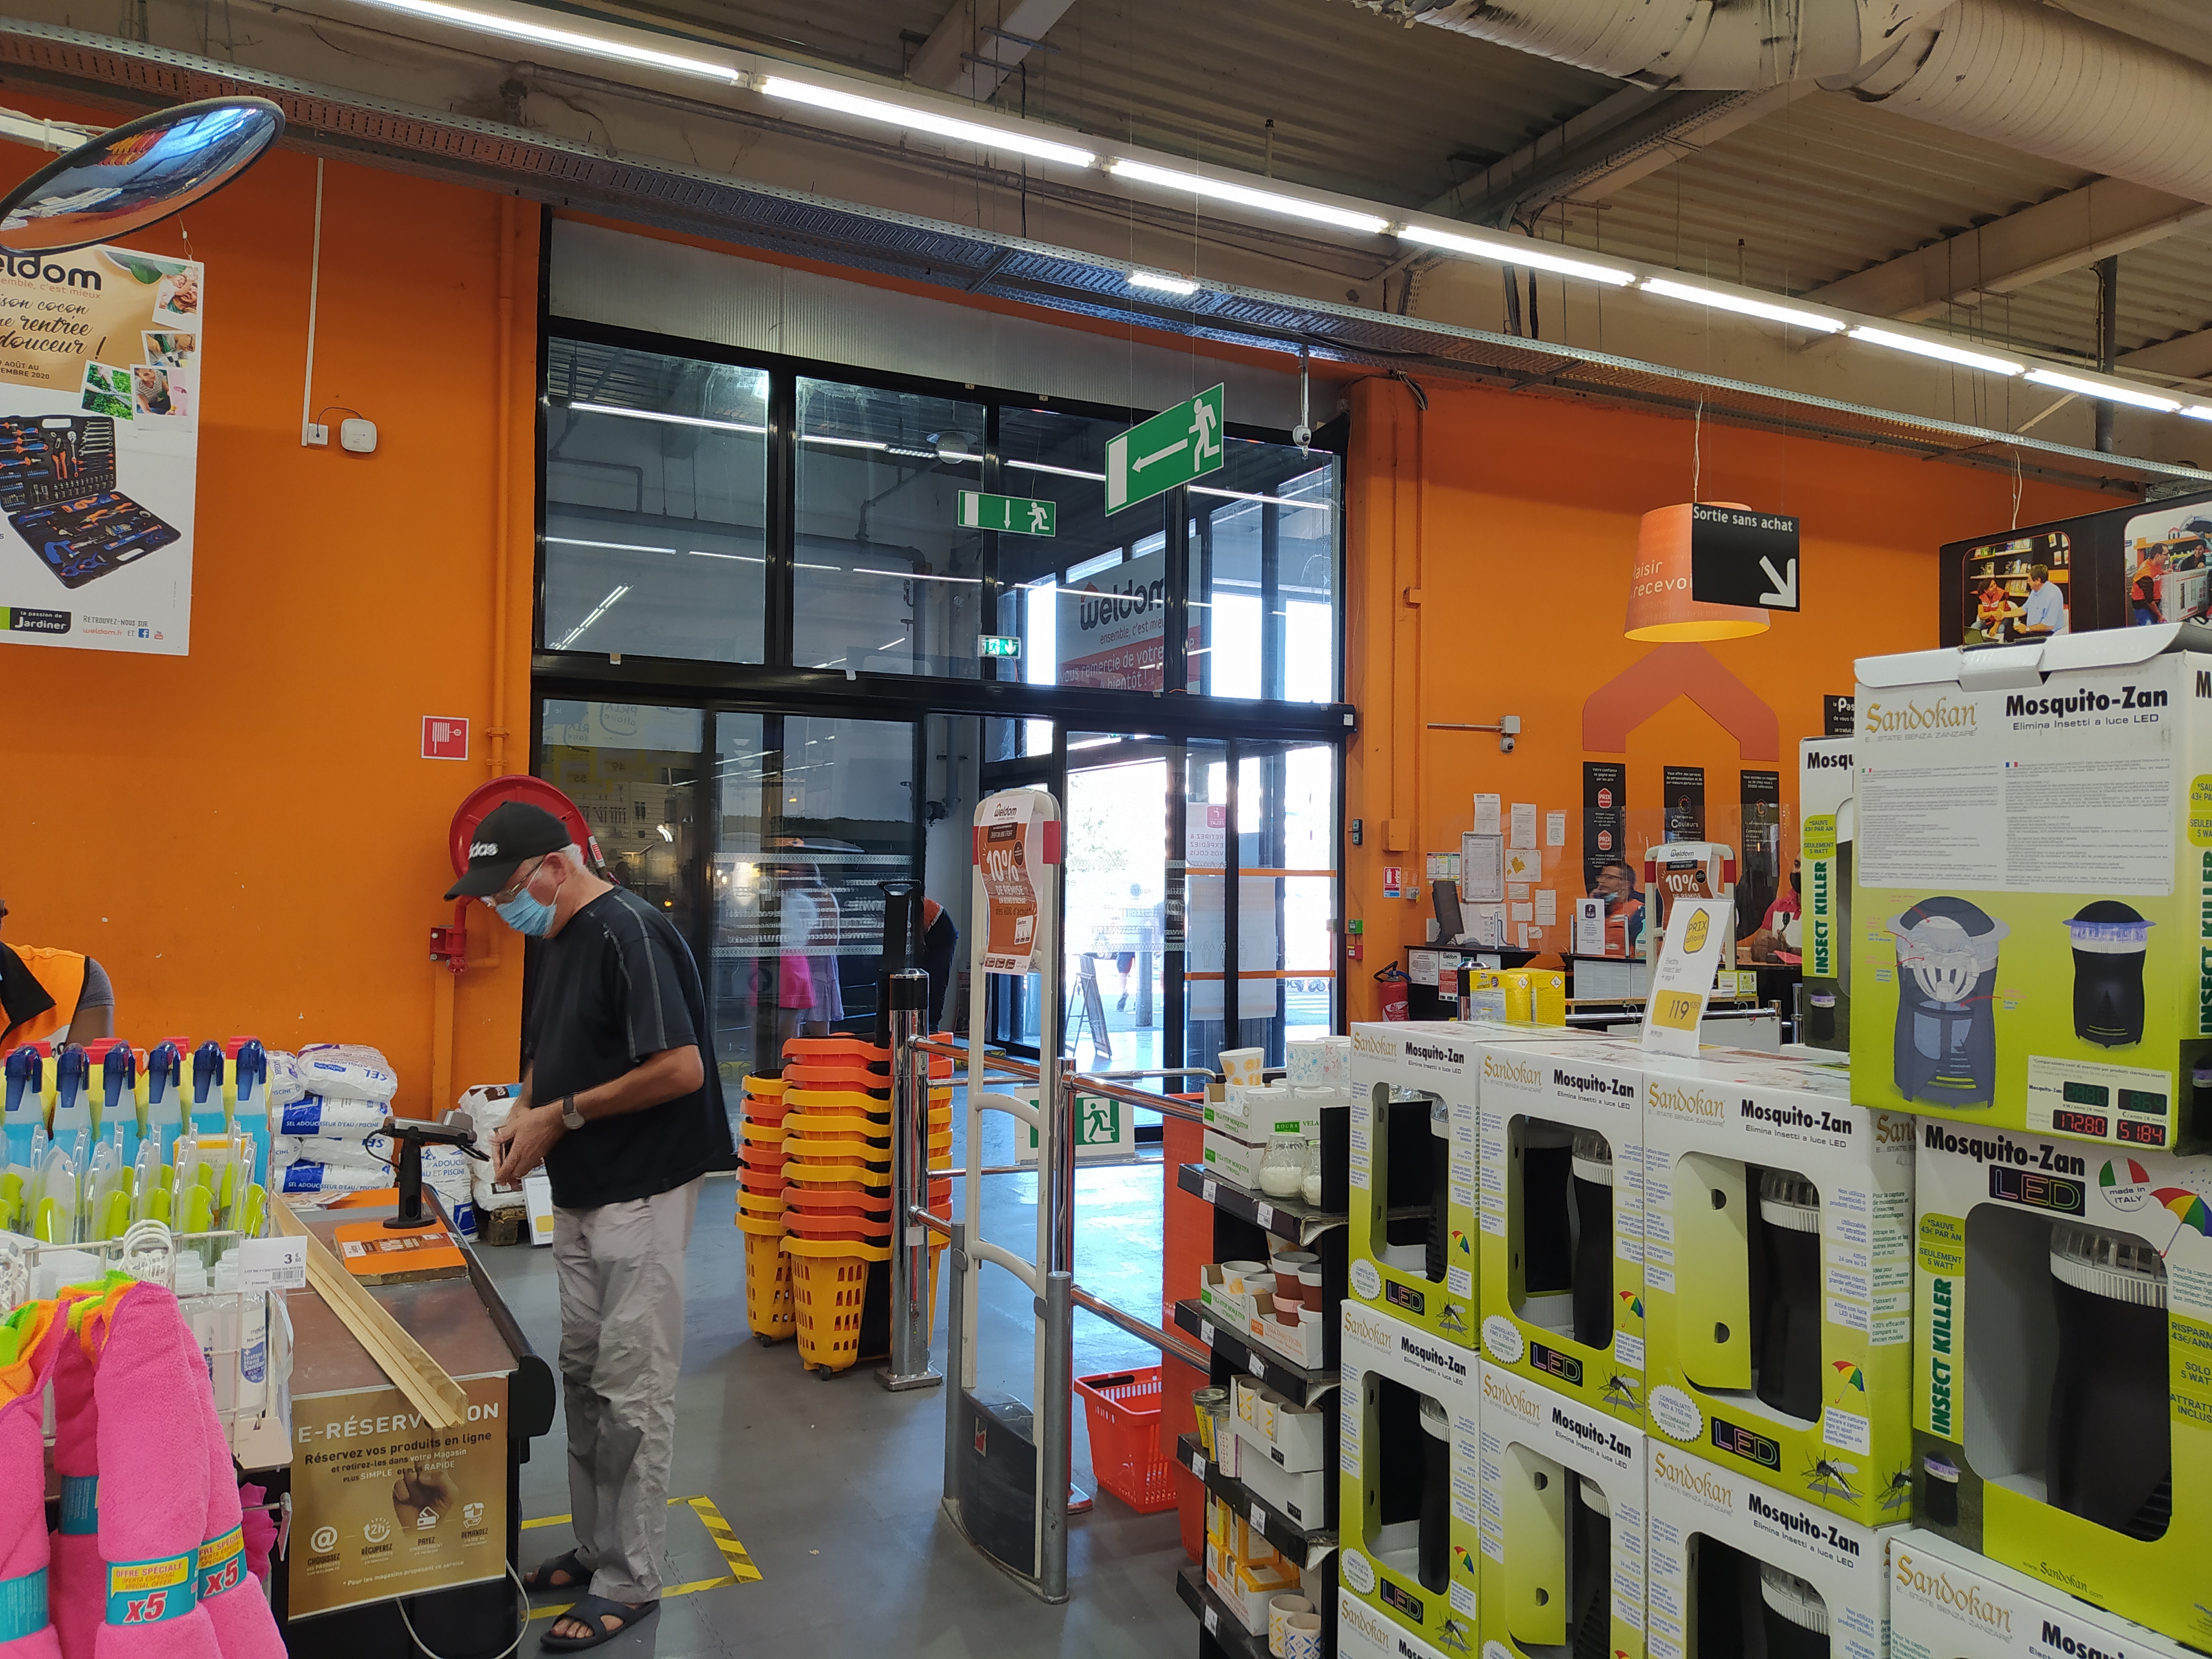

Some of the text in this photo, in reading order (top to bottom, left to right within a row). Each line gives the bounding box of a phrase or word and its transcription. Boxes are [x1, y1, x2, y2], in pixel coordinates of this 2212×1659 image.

[0, 256, 101, 290] ldom
[40, 283, 66, 294] c'est
[70, 288, 101, 299] mieux
[37, 300, 90, 315] cocon
[20, 314, 93, 337] rentrée
[0, 330, 87, 354] douceur
[4, 361, 27, 369] AOÛT
[32, 372, 50, 380] 2020
[1693, 506, 1793, 532] Sortie sans achat
[14, 616, 67, 630] Jardiner
[1100, 625, 1131, 645] ensemble,
[1132, 621, 1149, 636] c'est
[1060, 645, 1164, 684] vous remercie de votre
[1865, 686, 2168, 734] Sandokan Mosquito-Zan
[2013, 721, 2050, 731] Elimina
[2054, 718, 2090, 728] Insetti
[2105, 717, 2128, 725] luce
[2133, 714, 2159, 723] LED
[1671, 819, 1699, 828] Couleurs
[987, 849, 1019, 882] 10%
[995, 885, 1025, 895] DE REMISE
[1665, 874, 1699, 892] 10%
[1687, 920, 1708, 933] PRIX
[1814, 862, 1829, 974] INSECT KILLER
[1686, 933, 1705, 945] affaire
[1669, 1000, 1689, 1020] 119
[1354, 1031, 1464, 1065] Sandokan Mosquito-Zan
[1484, 1054, 1635, 1099] Sandokan Mosquito-Zan
[1648, 1081, 1853, 1135] Sandokan Mosquito-Zan
[1745, 1124, 1847, 1149] Elimina Insetti luce LED
[1925, 1124, 2085, 1176] Mosquito-Zan
[1994, 1167, 2081, 1211] LED
[2114, 1195, 2142, 1204] ITALY
[1921, 1226, 1962, 1241] 43€ PAR AN
[284, 1253, 293, 1264] 3
[1919, 1247, 1963, 1264] SEULEMENT
[1927, 1256, 1954, 1271] 5 WATT
[1387, 1286, 1423, 1312] LED
[1344, 1312, 1467, 1377] Sandokan Mosquito-Zan
[1532, 1344, 1580, 1381] LED
[1932, 1278, 1953, 1437] INSECT KILLER
[2185, 1361, 2211, 1376] SOLO
[298, 1402, 499, 1443] E-RÉSERVON
[1483, 1374, 1632, 1459] Sandokan Mosquito-Zan
[305, 1431, 492, 1465] Réservez vos produits en ligne
[1715, 1420, 1777, 1465] LED
[389, 1457, 408, 1465] dans
[410, 1453, 431, 1462] votre
[434, 1448, 467, 1460] Magasin
[361, 1469, 393, 1480] SIMPLE
[424, 1460, 455, 1472] RAPIDE
[1655, 1452, 1860, 1556] Sandokan Mosquito-Zan
[371, 1522, 385, 1535] 2h
[418, 1536, 435, 1546] PAYEZ
[116, 1562, 182, 1577] OFFRE SPÉCIALE
[204, 1557, 239, 1597] x5
[2039, 1561, 2088, 1593] Sandokan
[1897, 1554, 2012, 1632] Sandokan
[123, 1590, 168, 1623] x5
